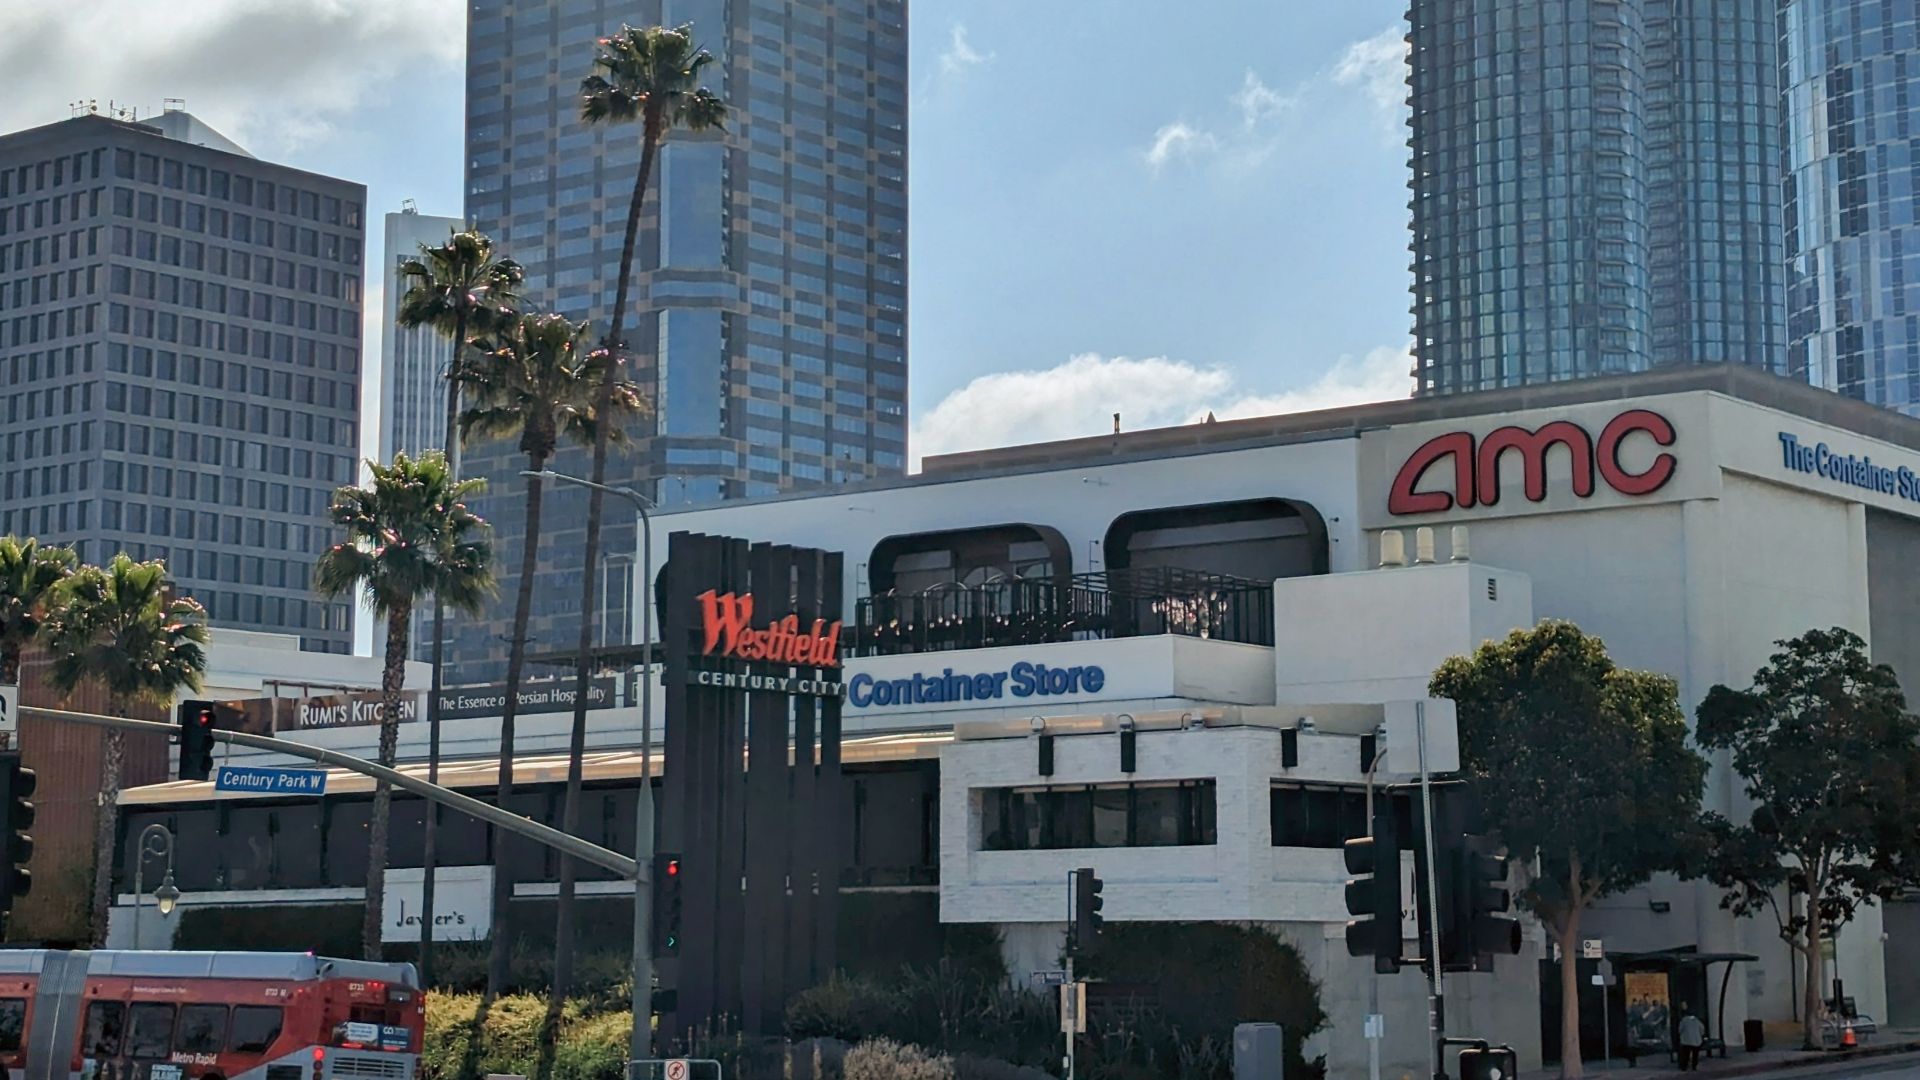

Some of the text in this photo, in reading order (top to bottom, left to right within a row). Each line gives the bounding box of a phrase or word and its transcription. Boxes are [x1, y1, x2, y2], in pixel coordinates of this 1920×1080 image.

[1778, 431, 1815, 474] The
[1815, 442, 1898, 495] Container
[696, 588, 844, 667] Westfield
[698, 670, 842, 695] CENTURY CITY
[850, 661, 1105, 708] Container Store
[439, 697, 456, 710] The
[458, 695, 496, 709] Essence
[551, 686, 606, 704] Hosplity
[300, 700, 415, 726] RUMI'S KITCEN
[223, 771, 321, 790] Century Park W
[396, 898, 465, 927] Javer's
[172, 1052, 217, 1066] Metro Rapid
